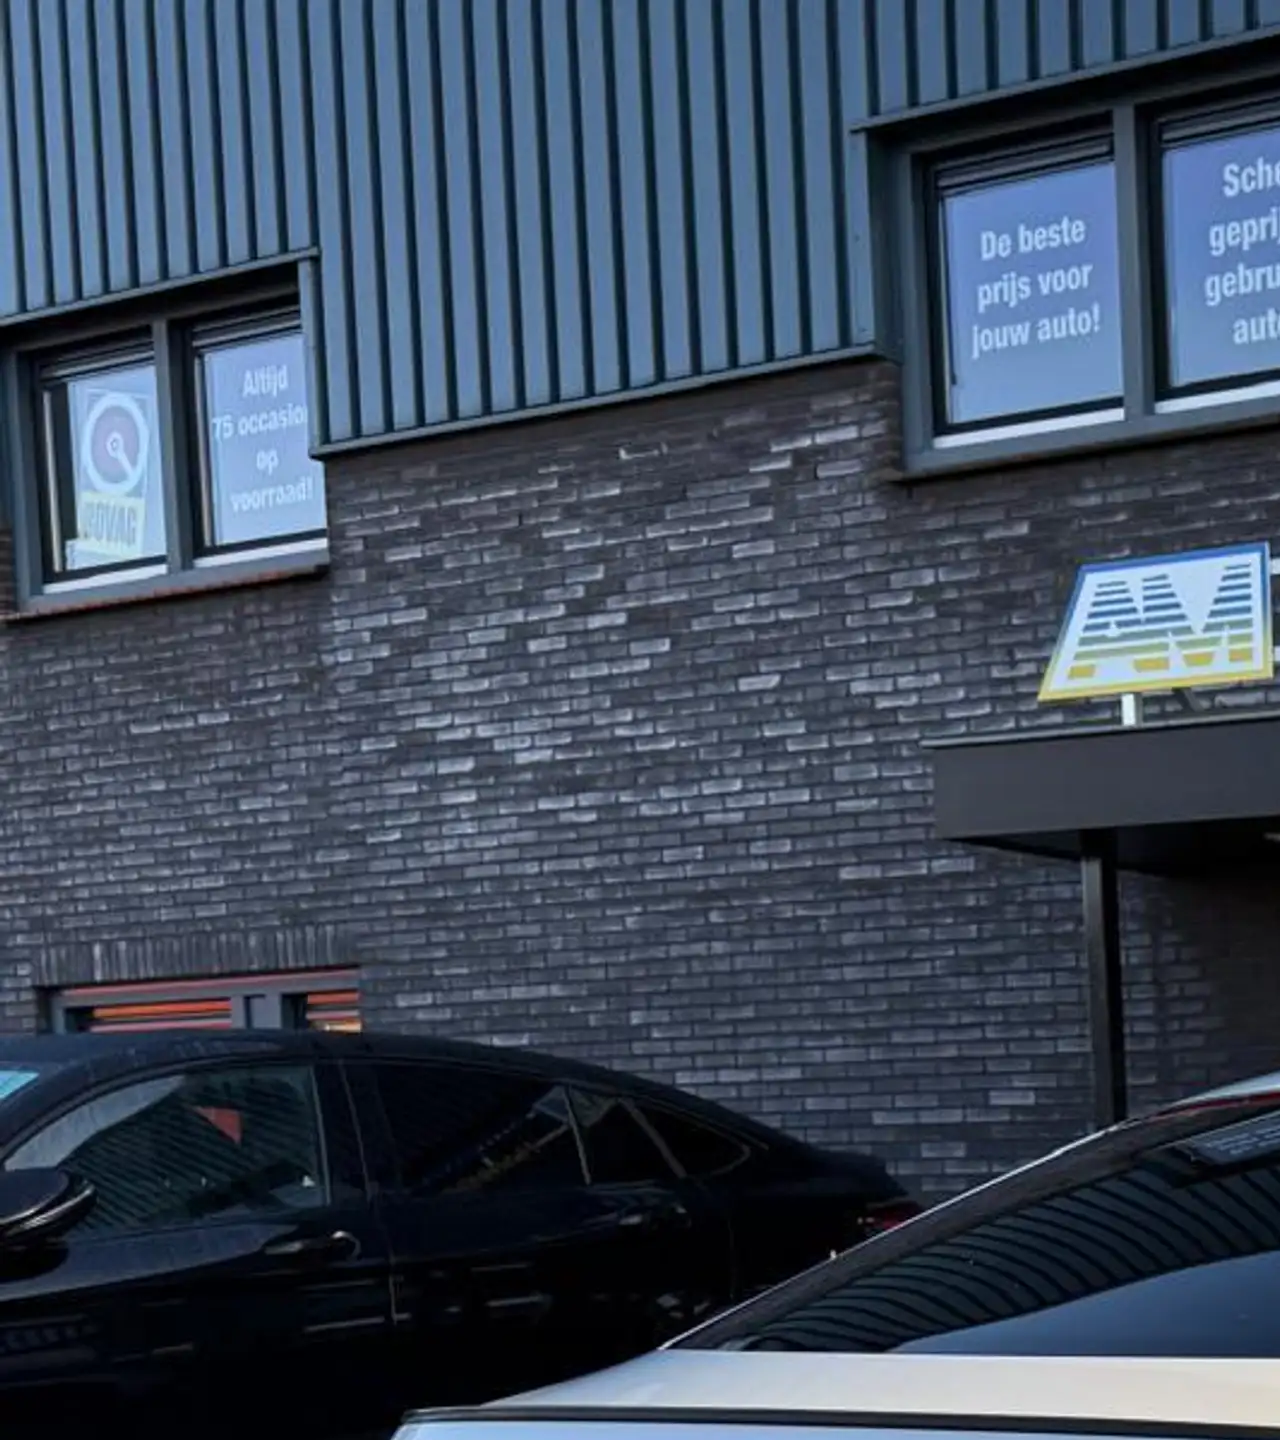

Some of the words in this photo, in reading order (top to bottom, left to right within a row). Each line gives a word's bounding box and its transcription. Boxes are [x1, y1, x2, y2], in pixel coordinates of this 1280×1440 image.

[981, 231, 1011, 261] De
[1018, 216, 1085, 255] beste
[977, 274, 1031, 313] prijs
[1039, 264, 1093, 296] voor
[971, 321, 1029, 359] jouw
[1037, 305, 1101, 343] auto!
[242, 364, 288, 397] Altijd
[256, 449, 278, 475] op
[230, 476, 313, 512] voorraad!
